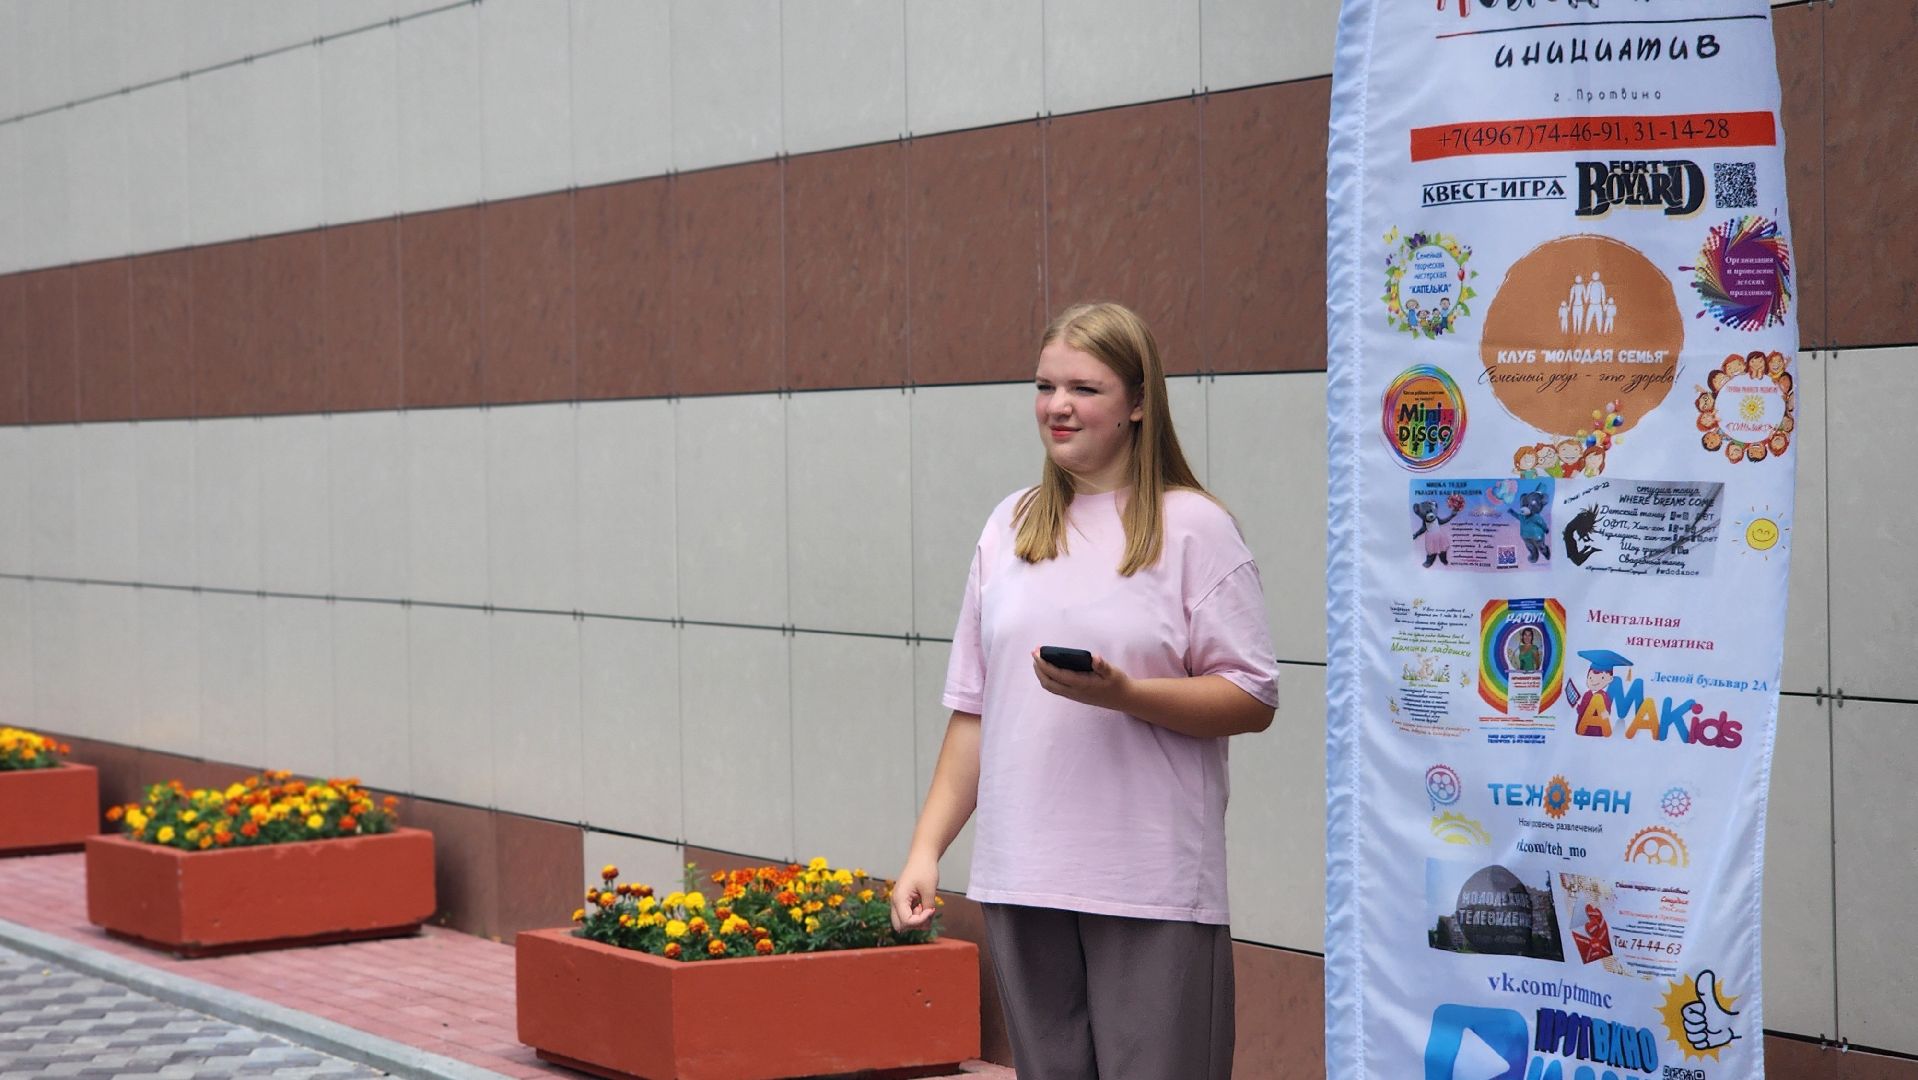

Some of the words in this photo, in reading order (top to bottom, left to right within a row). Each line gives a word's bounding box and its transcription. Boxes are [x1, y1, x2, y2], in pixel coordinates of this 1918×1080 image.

[1576, 88, 1662, 102] Протвино
[1633, 118, 1730, 142] 31-14-28
[1609, 160, 1663, 174] FORT
[1421, 179, 1566, 205] КВЕСТ-ИГРА
[1575, 160, 1706, 216] BOYARD
[1497, 350, 1537, 364] КЛУБ
[1541, 349, 1614, 364] "МОЛОДАЯ
[1618, 350, 1670, 364] СЕМЬЯ"
[1536, 372, 1578, 394] досуг
[1600, 373, 1625, 383] это
[1399, 402, 1442, 422] Mini
[1399, 426, 1453, 443] DISCO
[1619, 495, 1650, 505] WHERE
[1653, 496, 1686, 507] DREAMS
[1587, 609, 1682, 628] Ментальная
[1625, 635, 1715, 651] математика
[1650, 671, 1694, 685] Лесной
[1697, 674, 1749, 692] бульвар
[1752, 679, 1768, 692] 2А
[1576, 675, 1743, 749] AMAKids
[1556, 822, 1603, 833] развлечений
[1488, 972, 1613, 1009] vk.com/ptmmc
